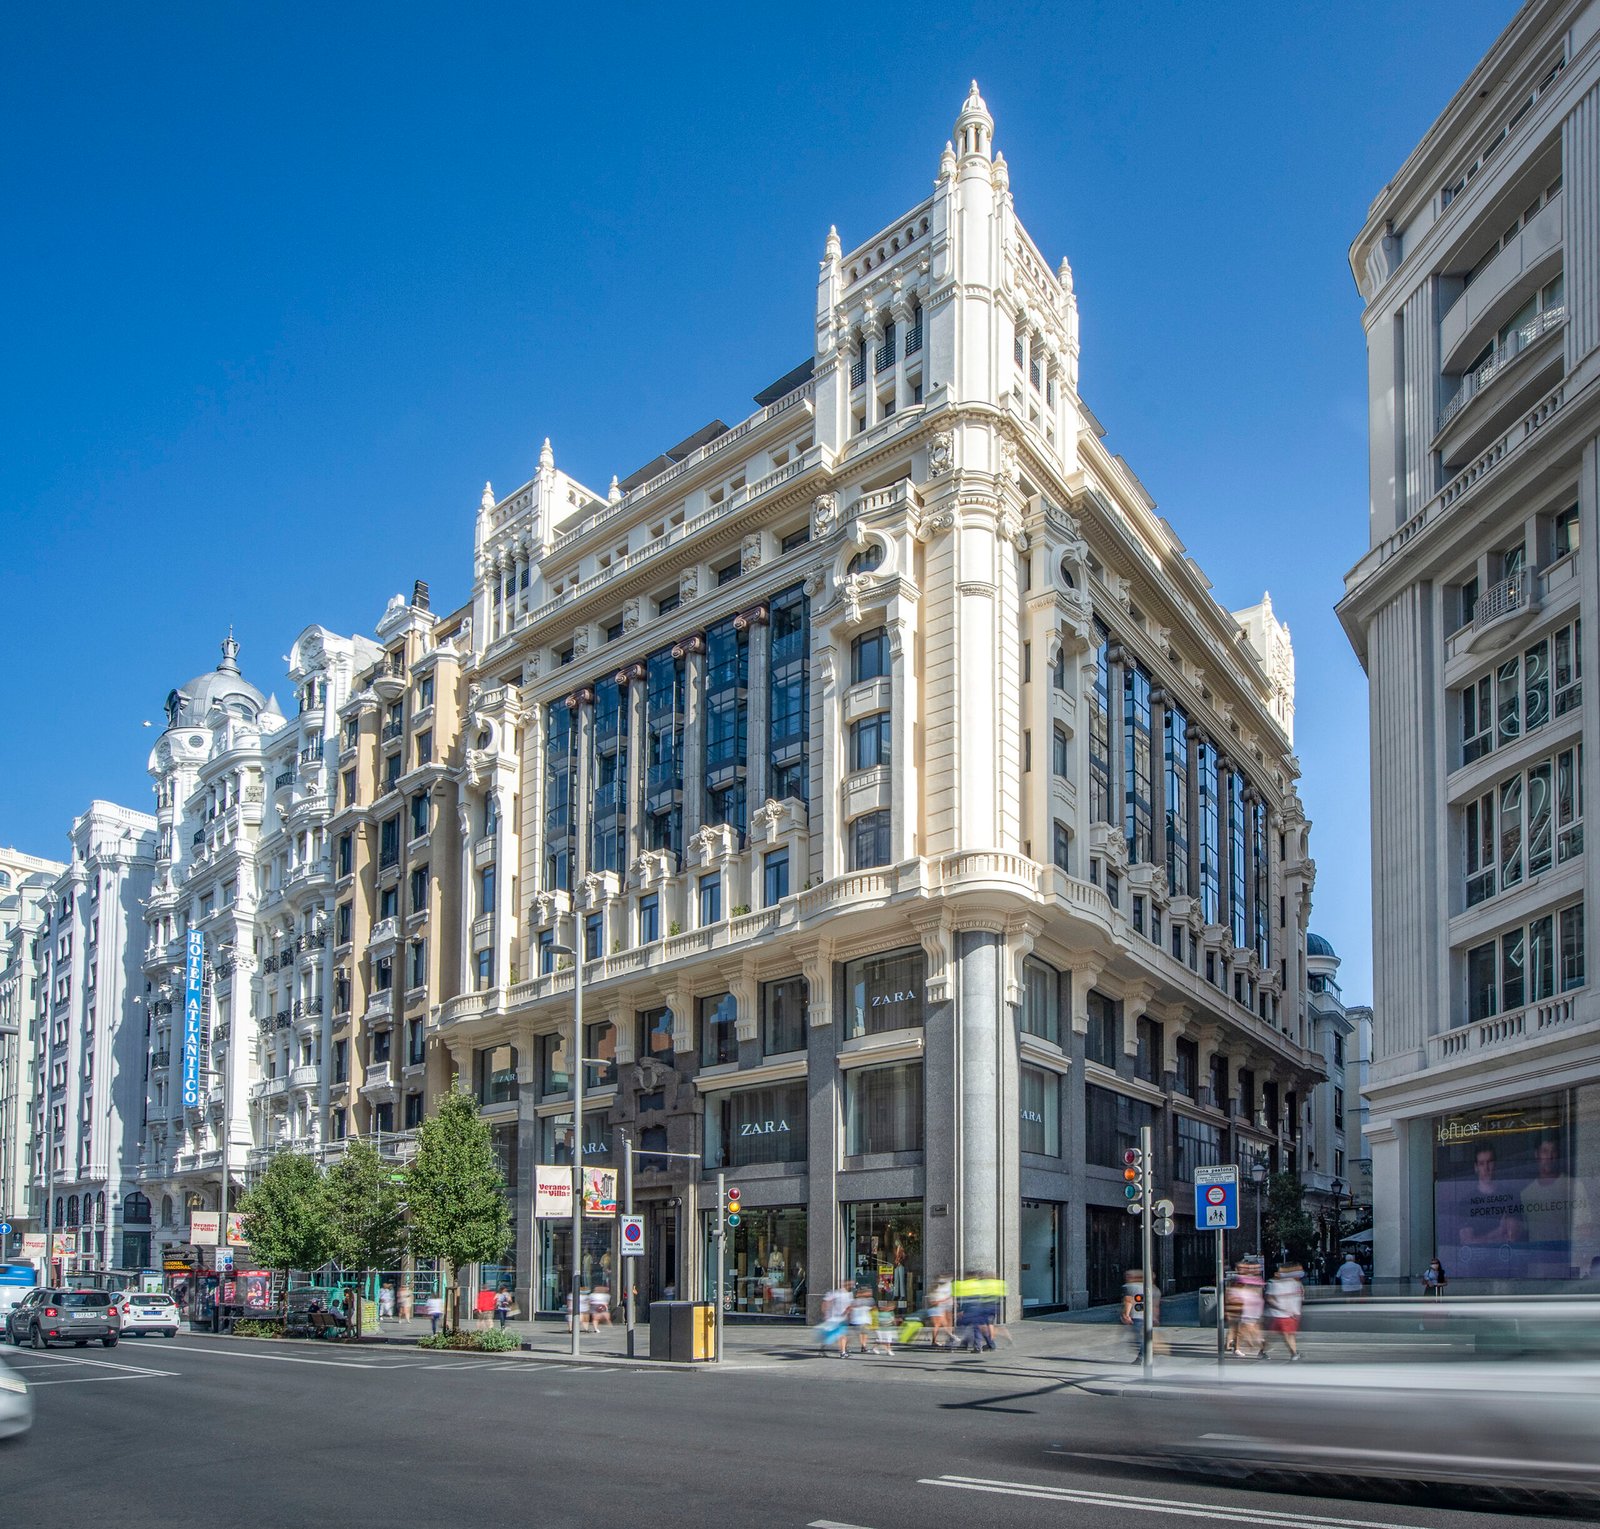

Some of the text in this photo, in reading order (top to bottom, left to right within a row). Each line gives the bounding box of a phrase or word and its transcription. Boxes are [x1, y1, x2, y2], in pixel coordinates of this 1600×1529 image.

[872, 990, 916, 1007] ZARA
[185, 933, 201, 1103] HOTEL ATLANTICO
[499, 1073, 517, 1083] ZAR
[1020, 1109, 1042, 1123] ARA
[741, 1119, 790, 1136] ZARA
[1437, 1121, 1480, 1142] lefties
[570, 1142, 608, 1155] ARA
[539, 1183, 571, 1191] Veranos
[1471, 1194, 1514, 1205] NEW SEASON
[1470, 1204, 1525, 1217] SPORTSWEAR
